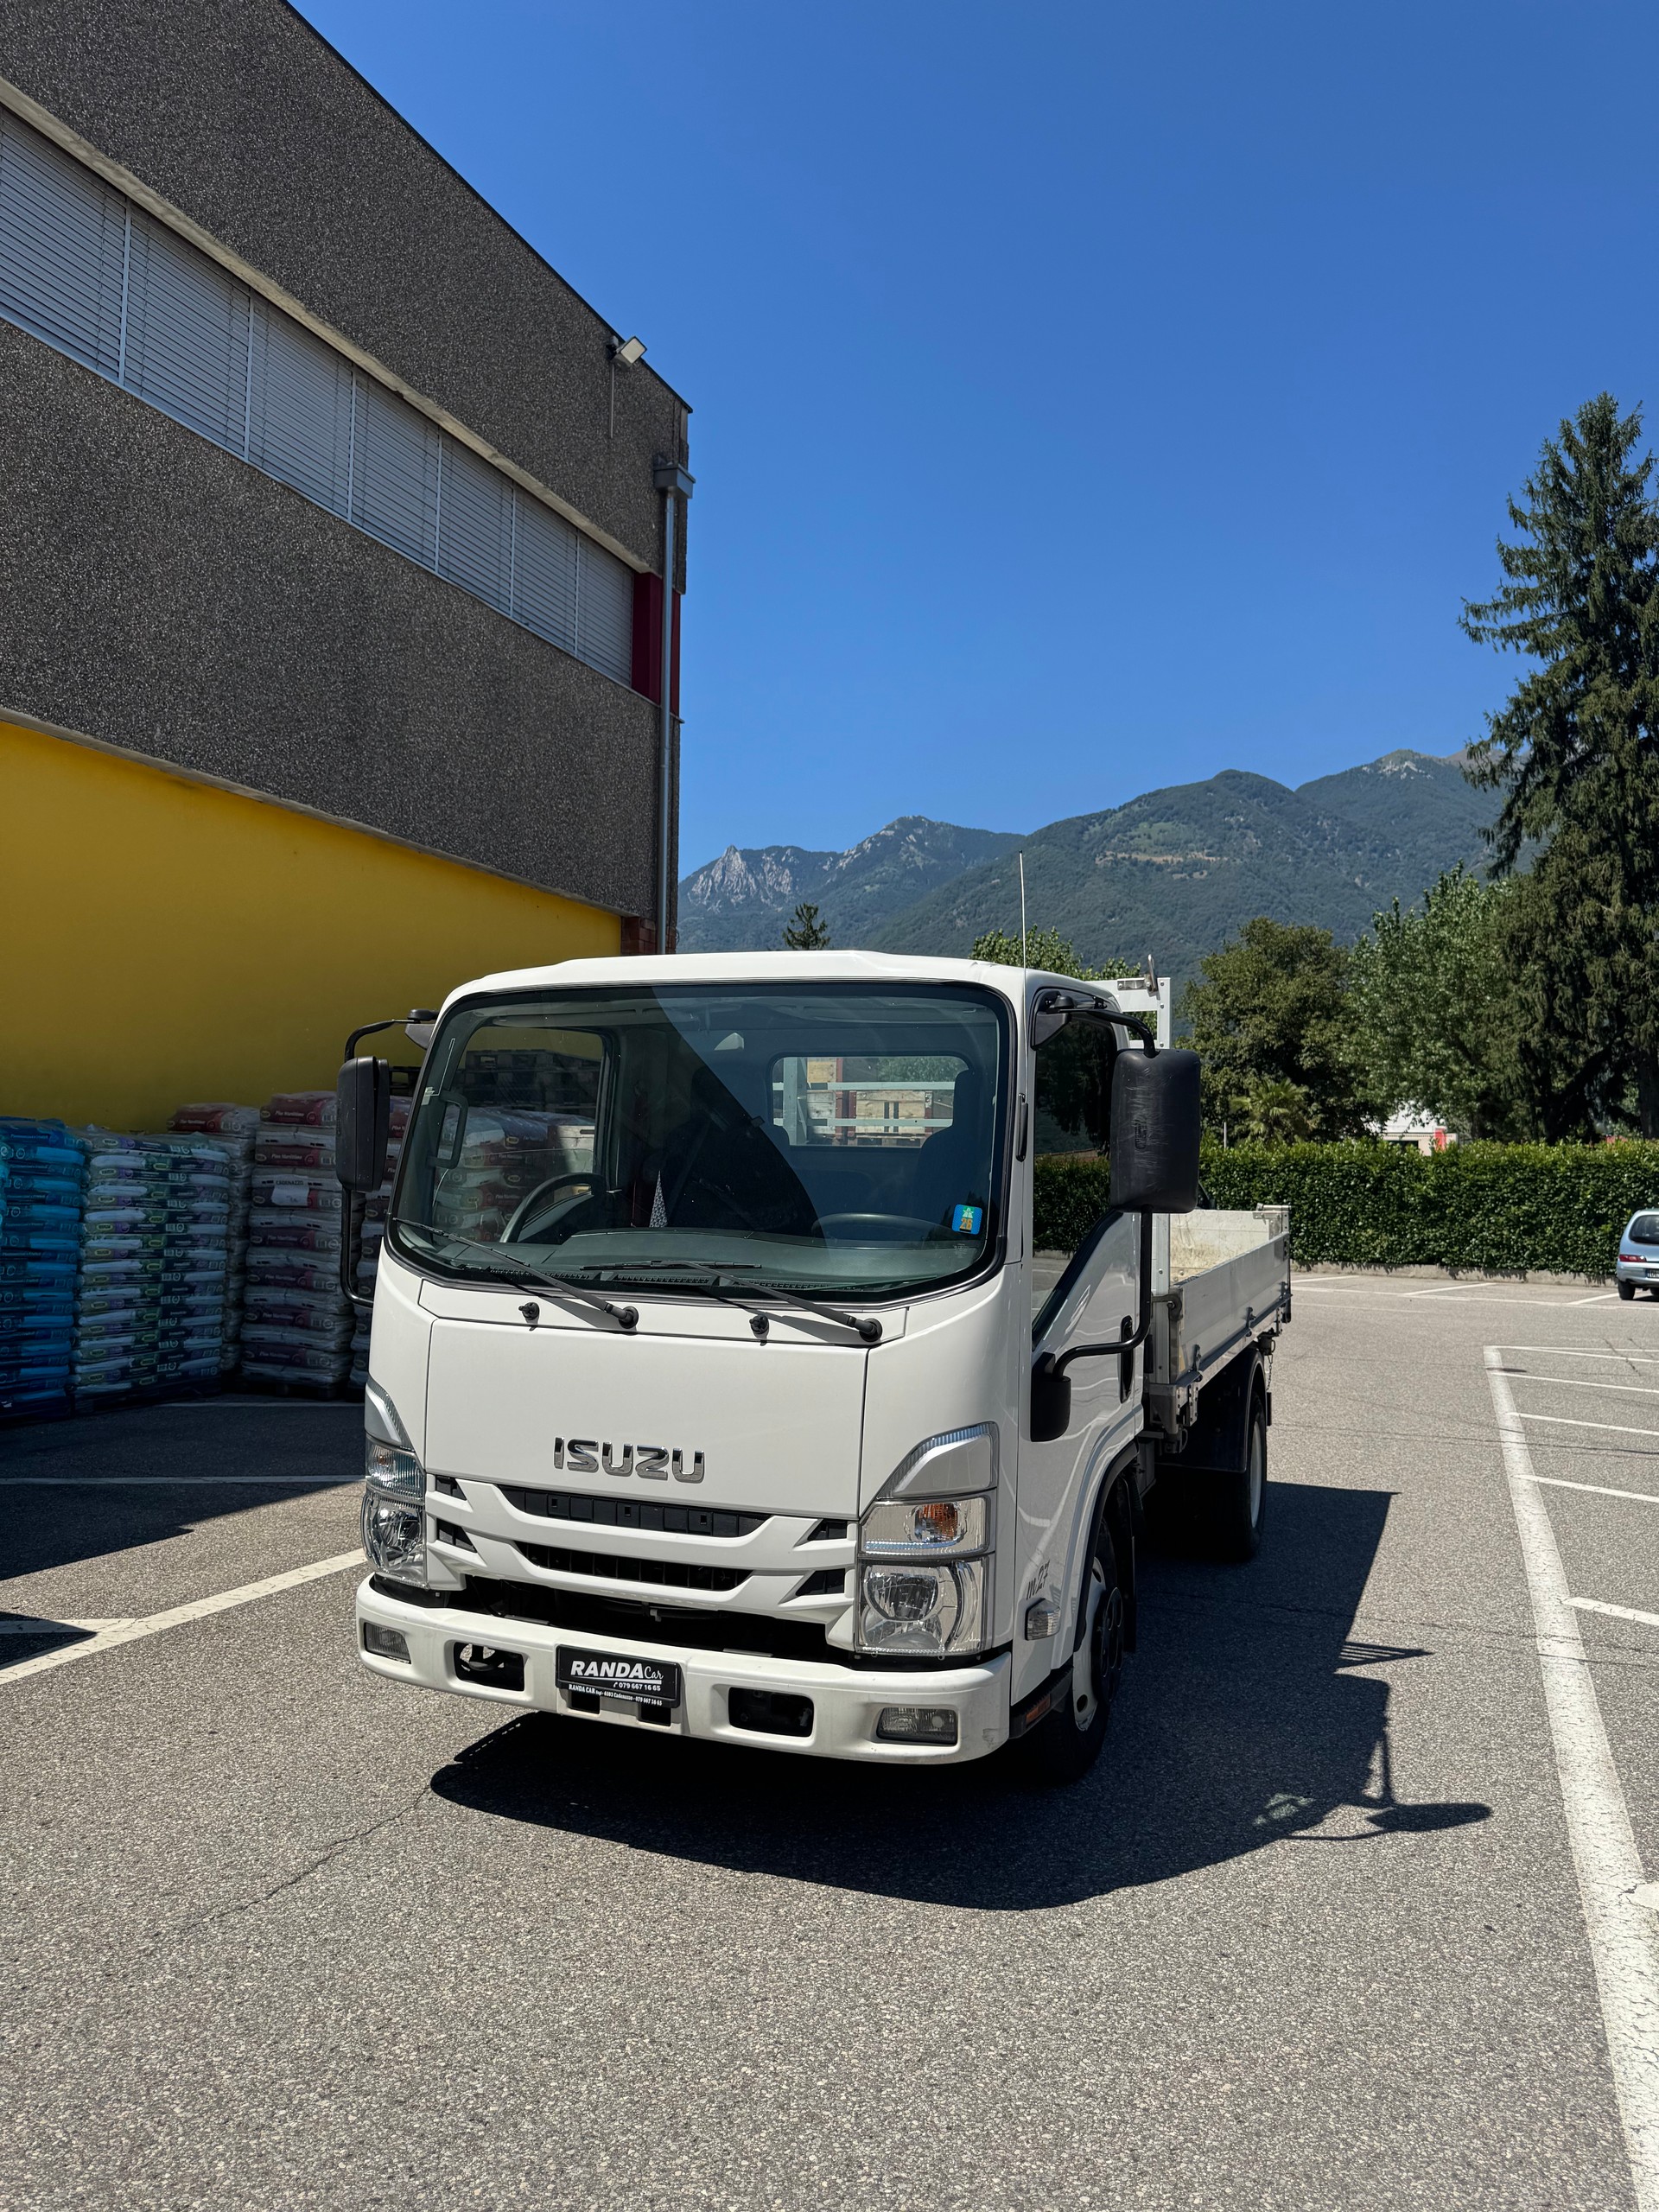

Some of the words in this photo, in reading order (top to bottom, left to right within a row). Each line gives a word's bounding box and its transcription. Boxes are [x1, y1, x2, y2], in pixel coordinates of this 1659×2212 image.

[554, 1437, 705, 1484] ISUZU
[570, 1660, 644, 1679] RANDA
[644, 1666, 664, 1680] Car
[568, 1684, 586, 1693] RANDA
